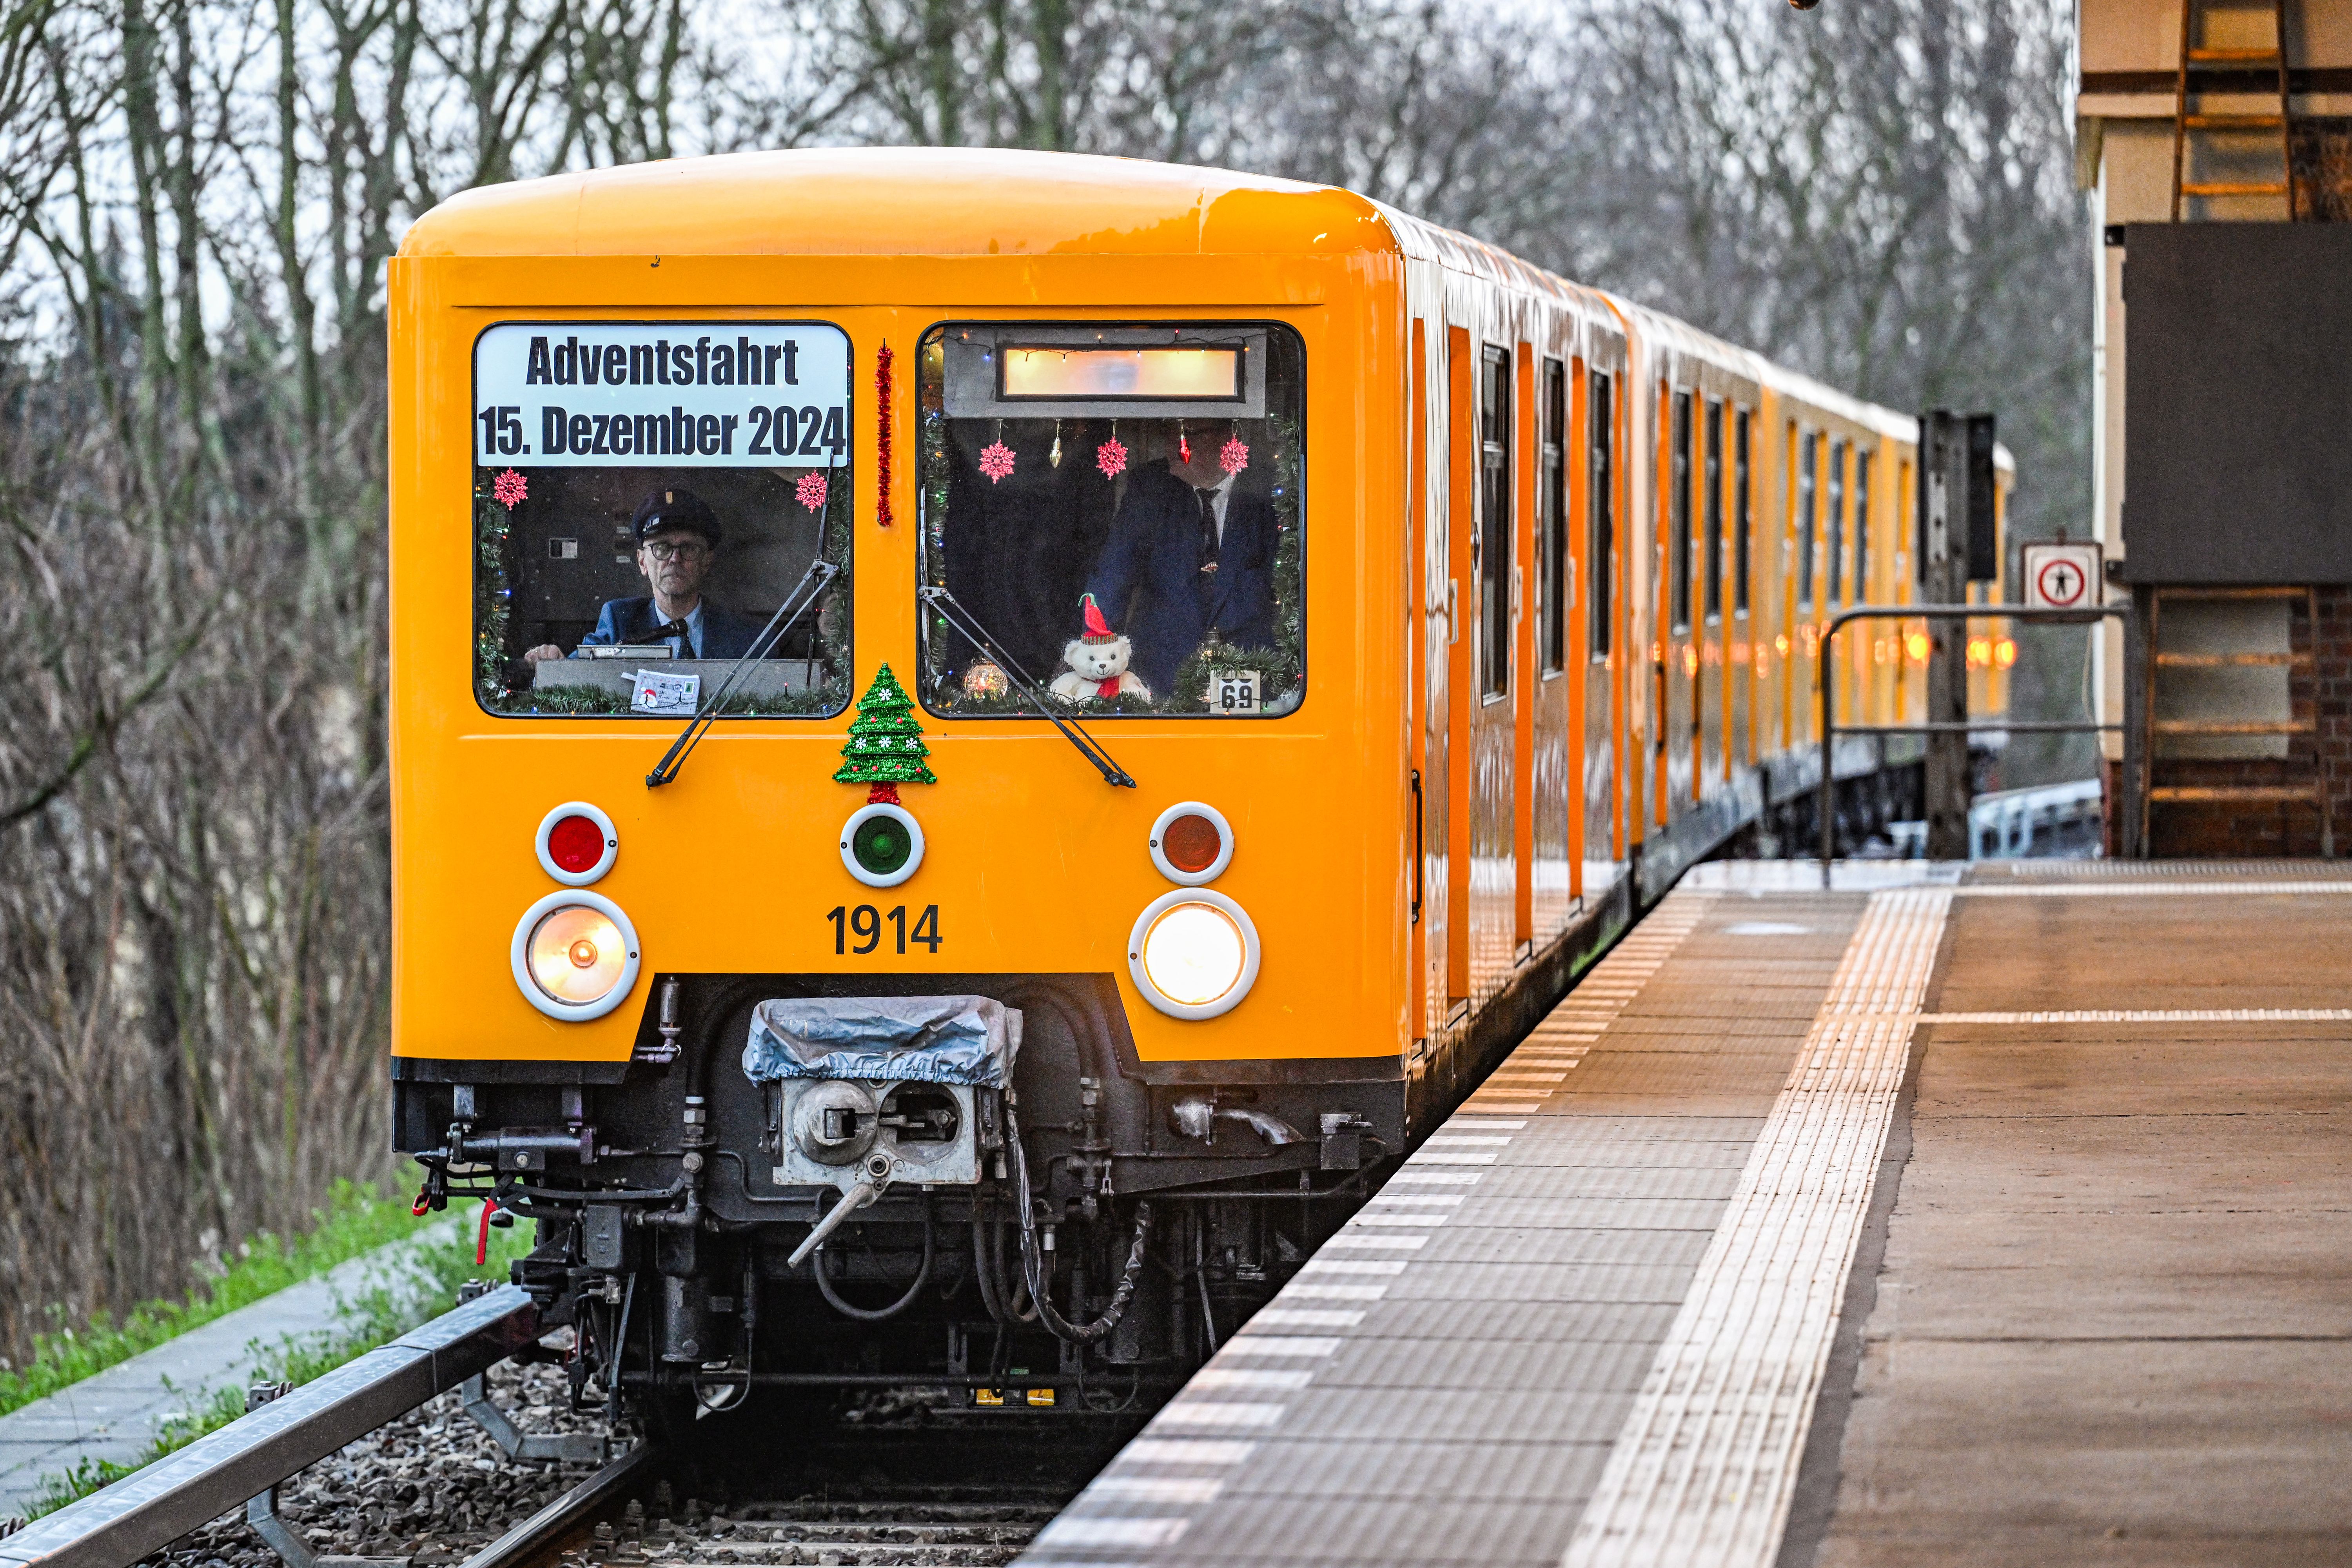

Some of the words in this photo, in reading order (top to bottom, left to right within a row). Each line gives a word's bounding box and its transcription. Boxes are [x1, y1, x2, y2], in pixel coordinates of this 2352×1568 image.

[526, 337, 799, 385] Adventsfahrt
[479, 406, 530, 456] 15.
[543, 406, 738, 456] Dezember
[749, 406, 846, 456] 2024
[1221, 685, 1252, 708] 69
[826, 904, 943, 955] 1914
